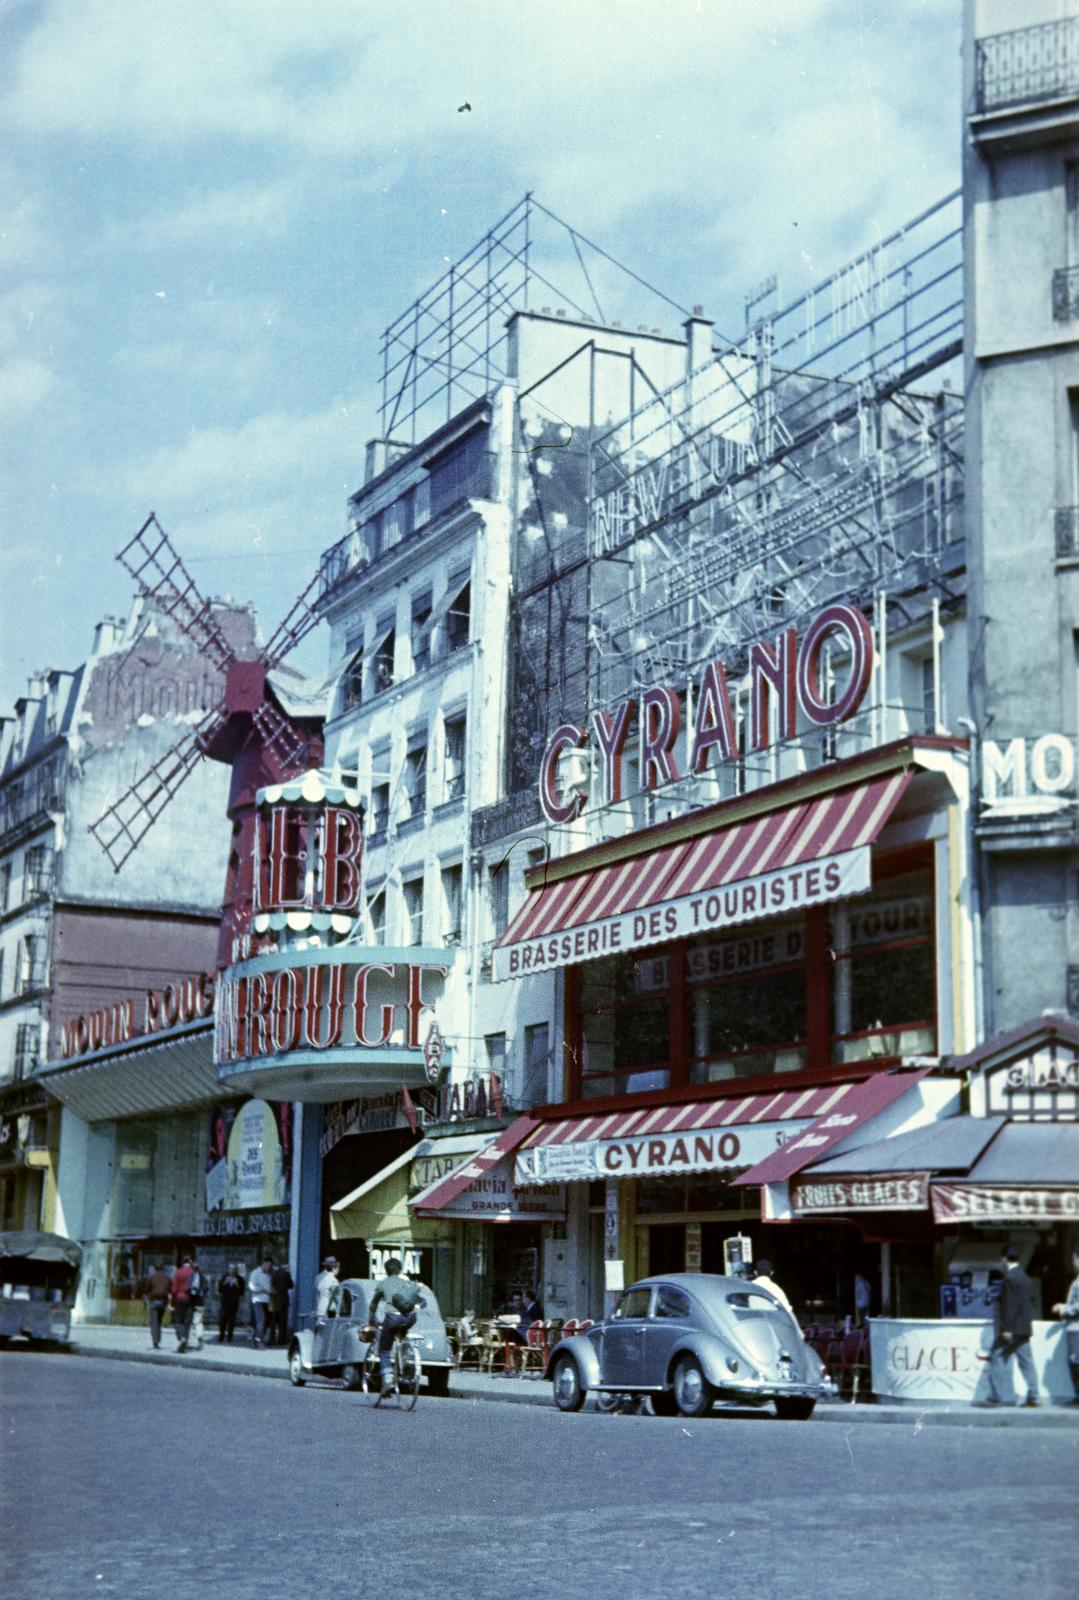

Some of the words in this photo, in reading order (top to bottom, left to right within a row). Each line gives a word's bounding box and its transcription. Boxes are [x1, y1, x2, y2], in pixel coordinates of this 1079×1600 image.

[539, 604, 874, 824] CYRANO
[981, 732, 1075, 799] MO
[509, 920, 622, 974] BRASSERIE
[633, 907, 678, 940] DES
[690, 862, 842, 926] TOURISTES
[60, 998, 134, 1059] MOULIN
[604, 1132, 741, 1171] CYRANO
[798, 1183, 846, 1208] FRUITS
[851, 1180, 922, 1205] GLACES
[951, 1189, 1047, 1216] SELECT
